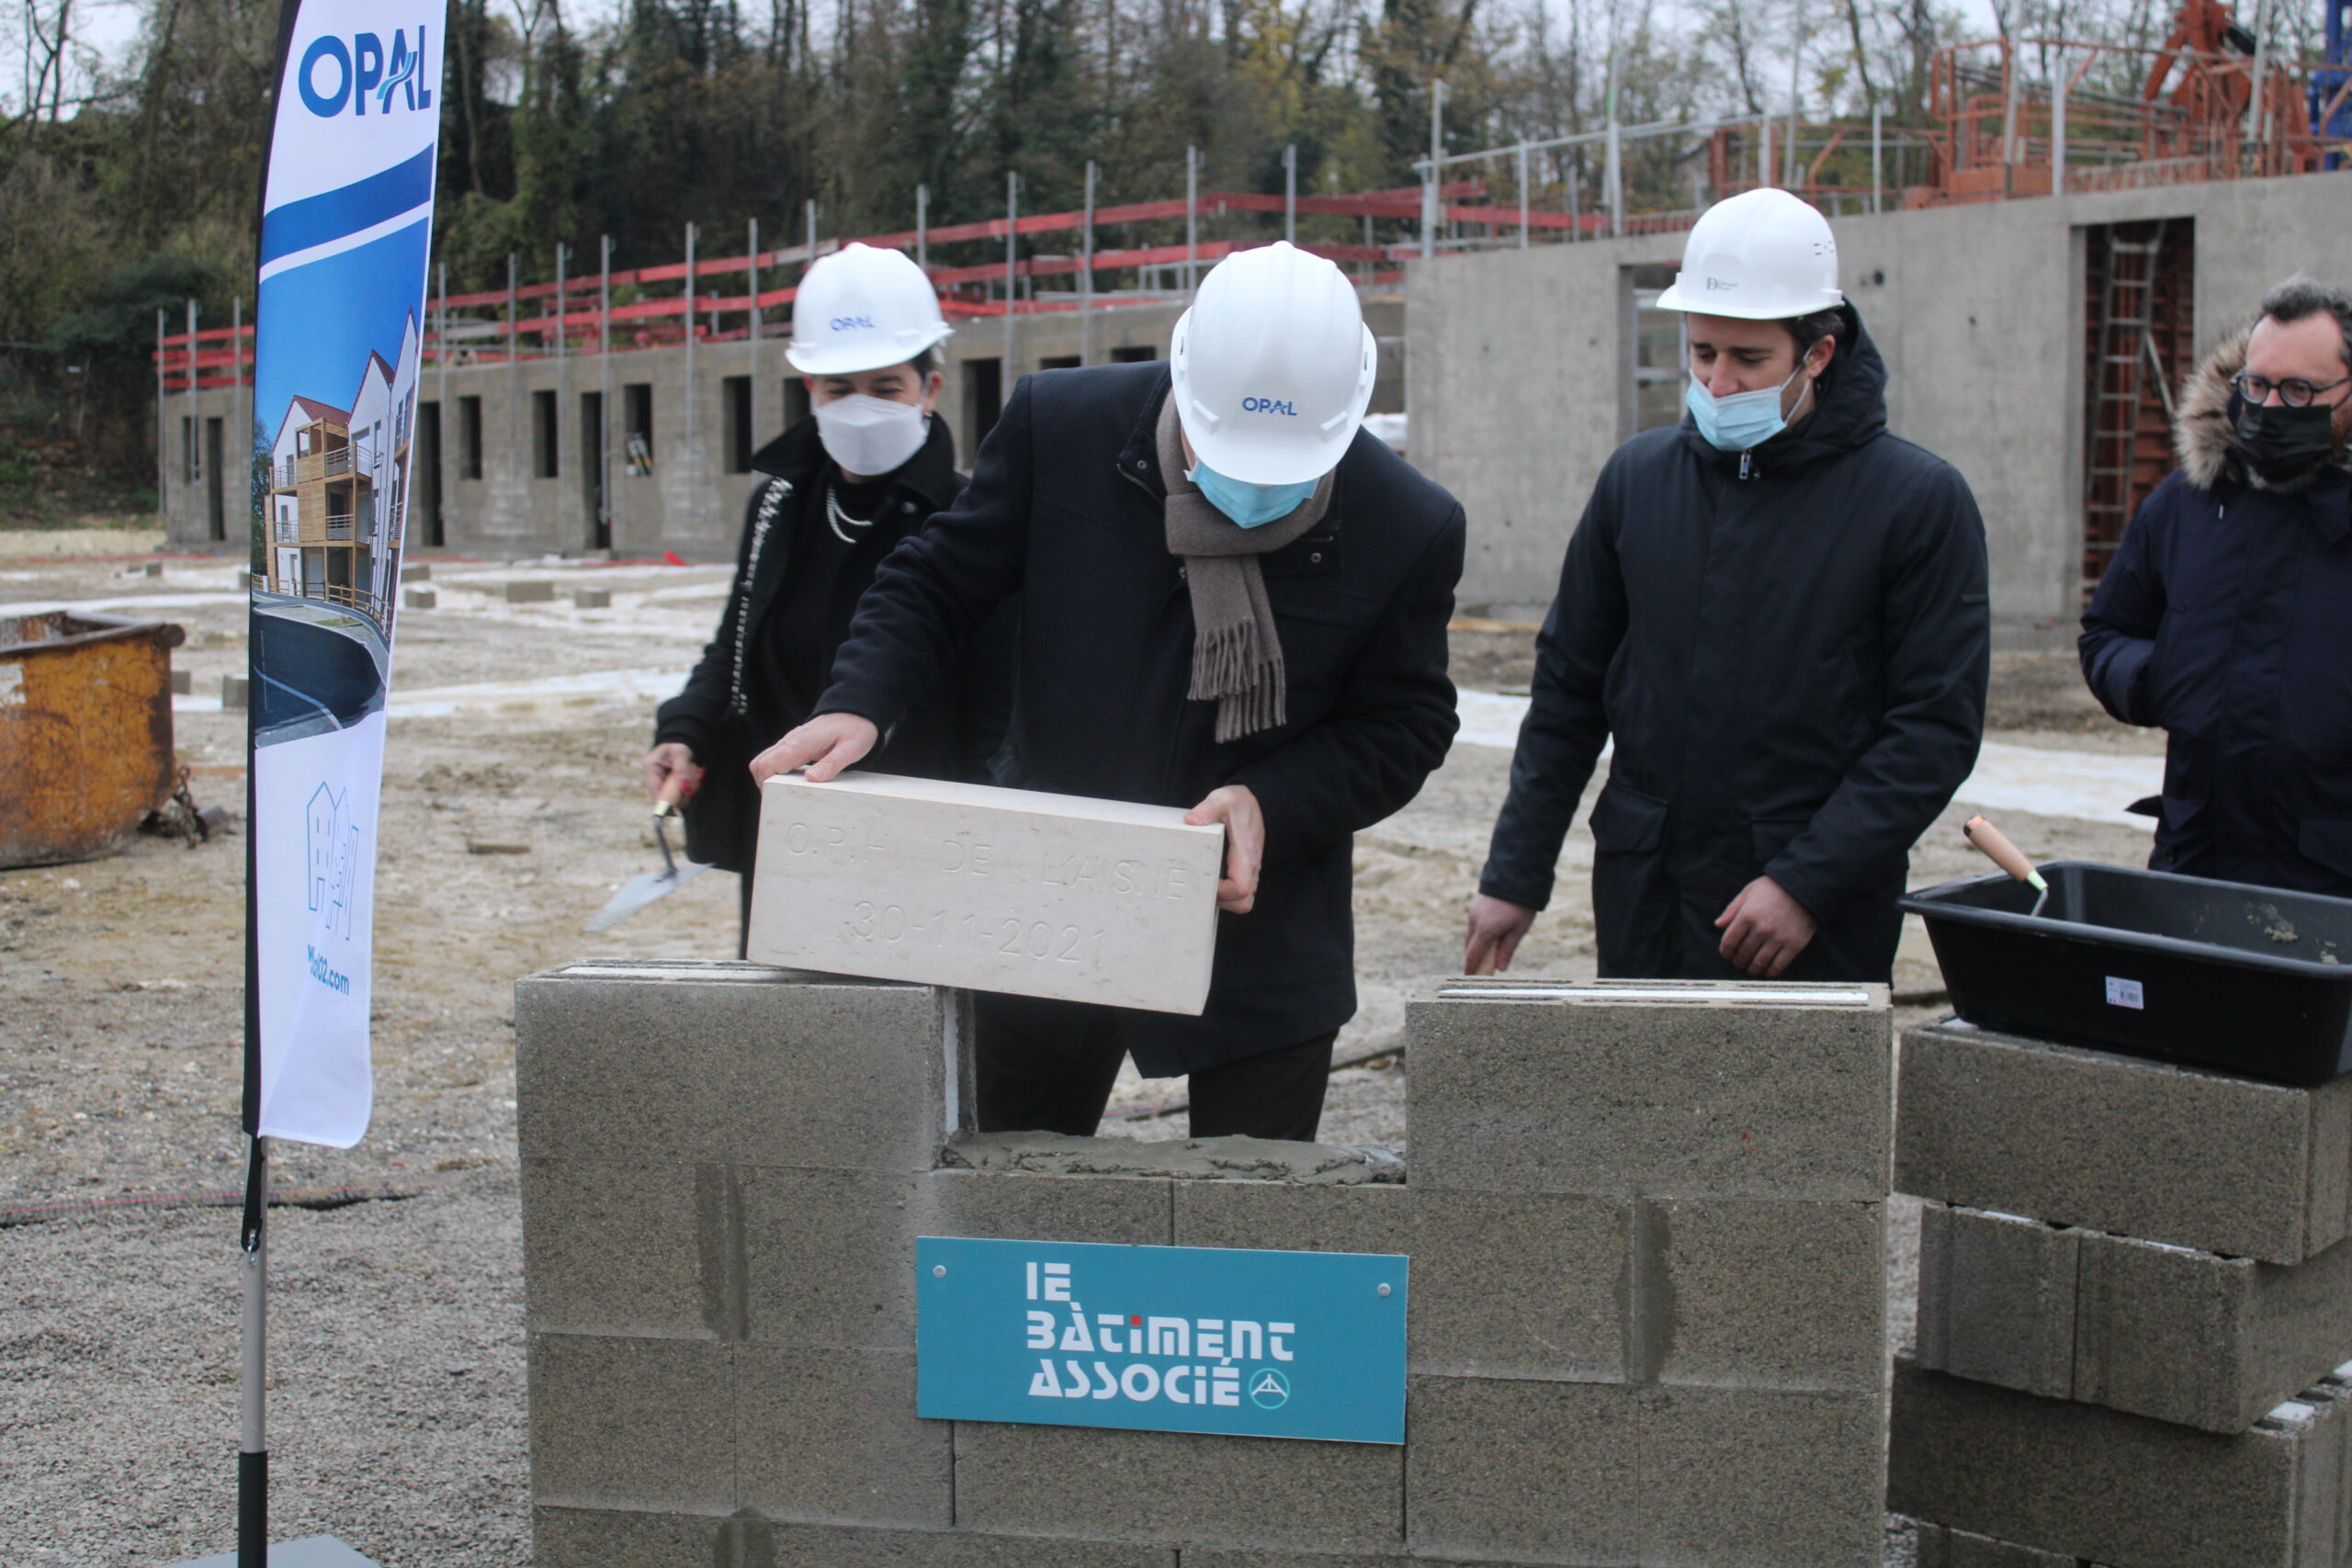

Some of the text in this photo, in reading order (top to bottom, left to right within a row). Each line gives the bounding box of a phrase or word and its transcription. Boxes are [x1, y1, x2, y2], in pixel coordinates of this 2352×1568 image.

[299, 25, 431, 118] OPAL
[830, 316, 876, 332] OPAL
[1242, 397, 1297, 416] OPAL
[941, 840, 992, 876] DE
[853, 900, 1106, 967] 30-11-2021
